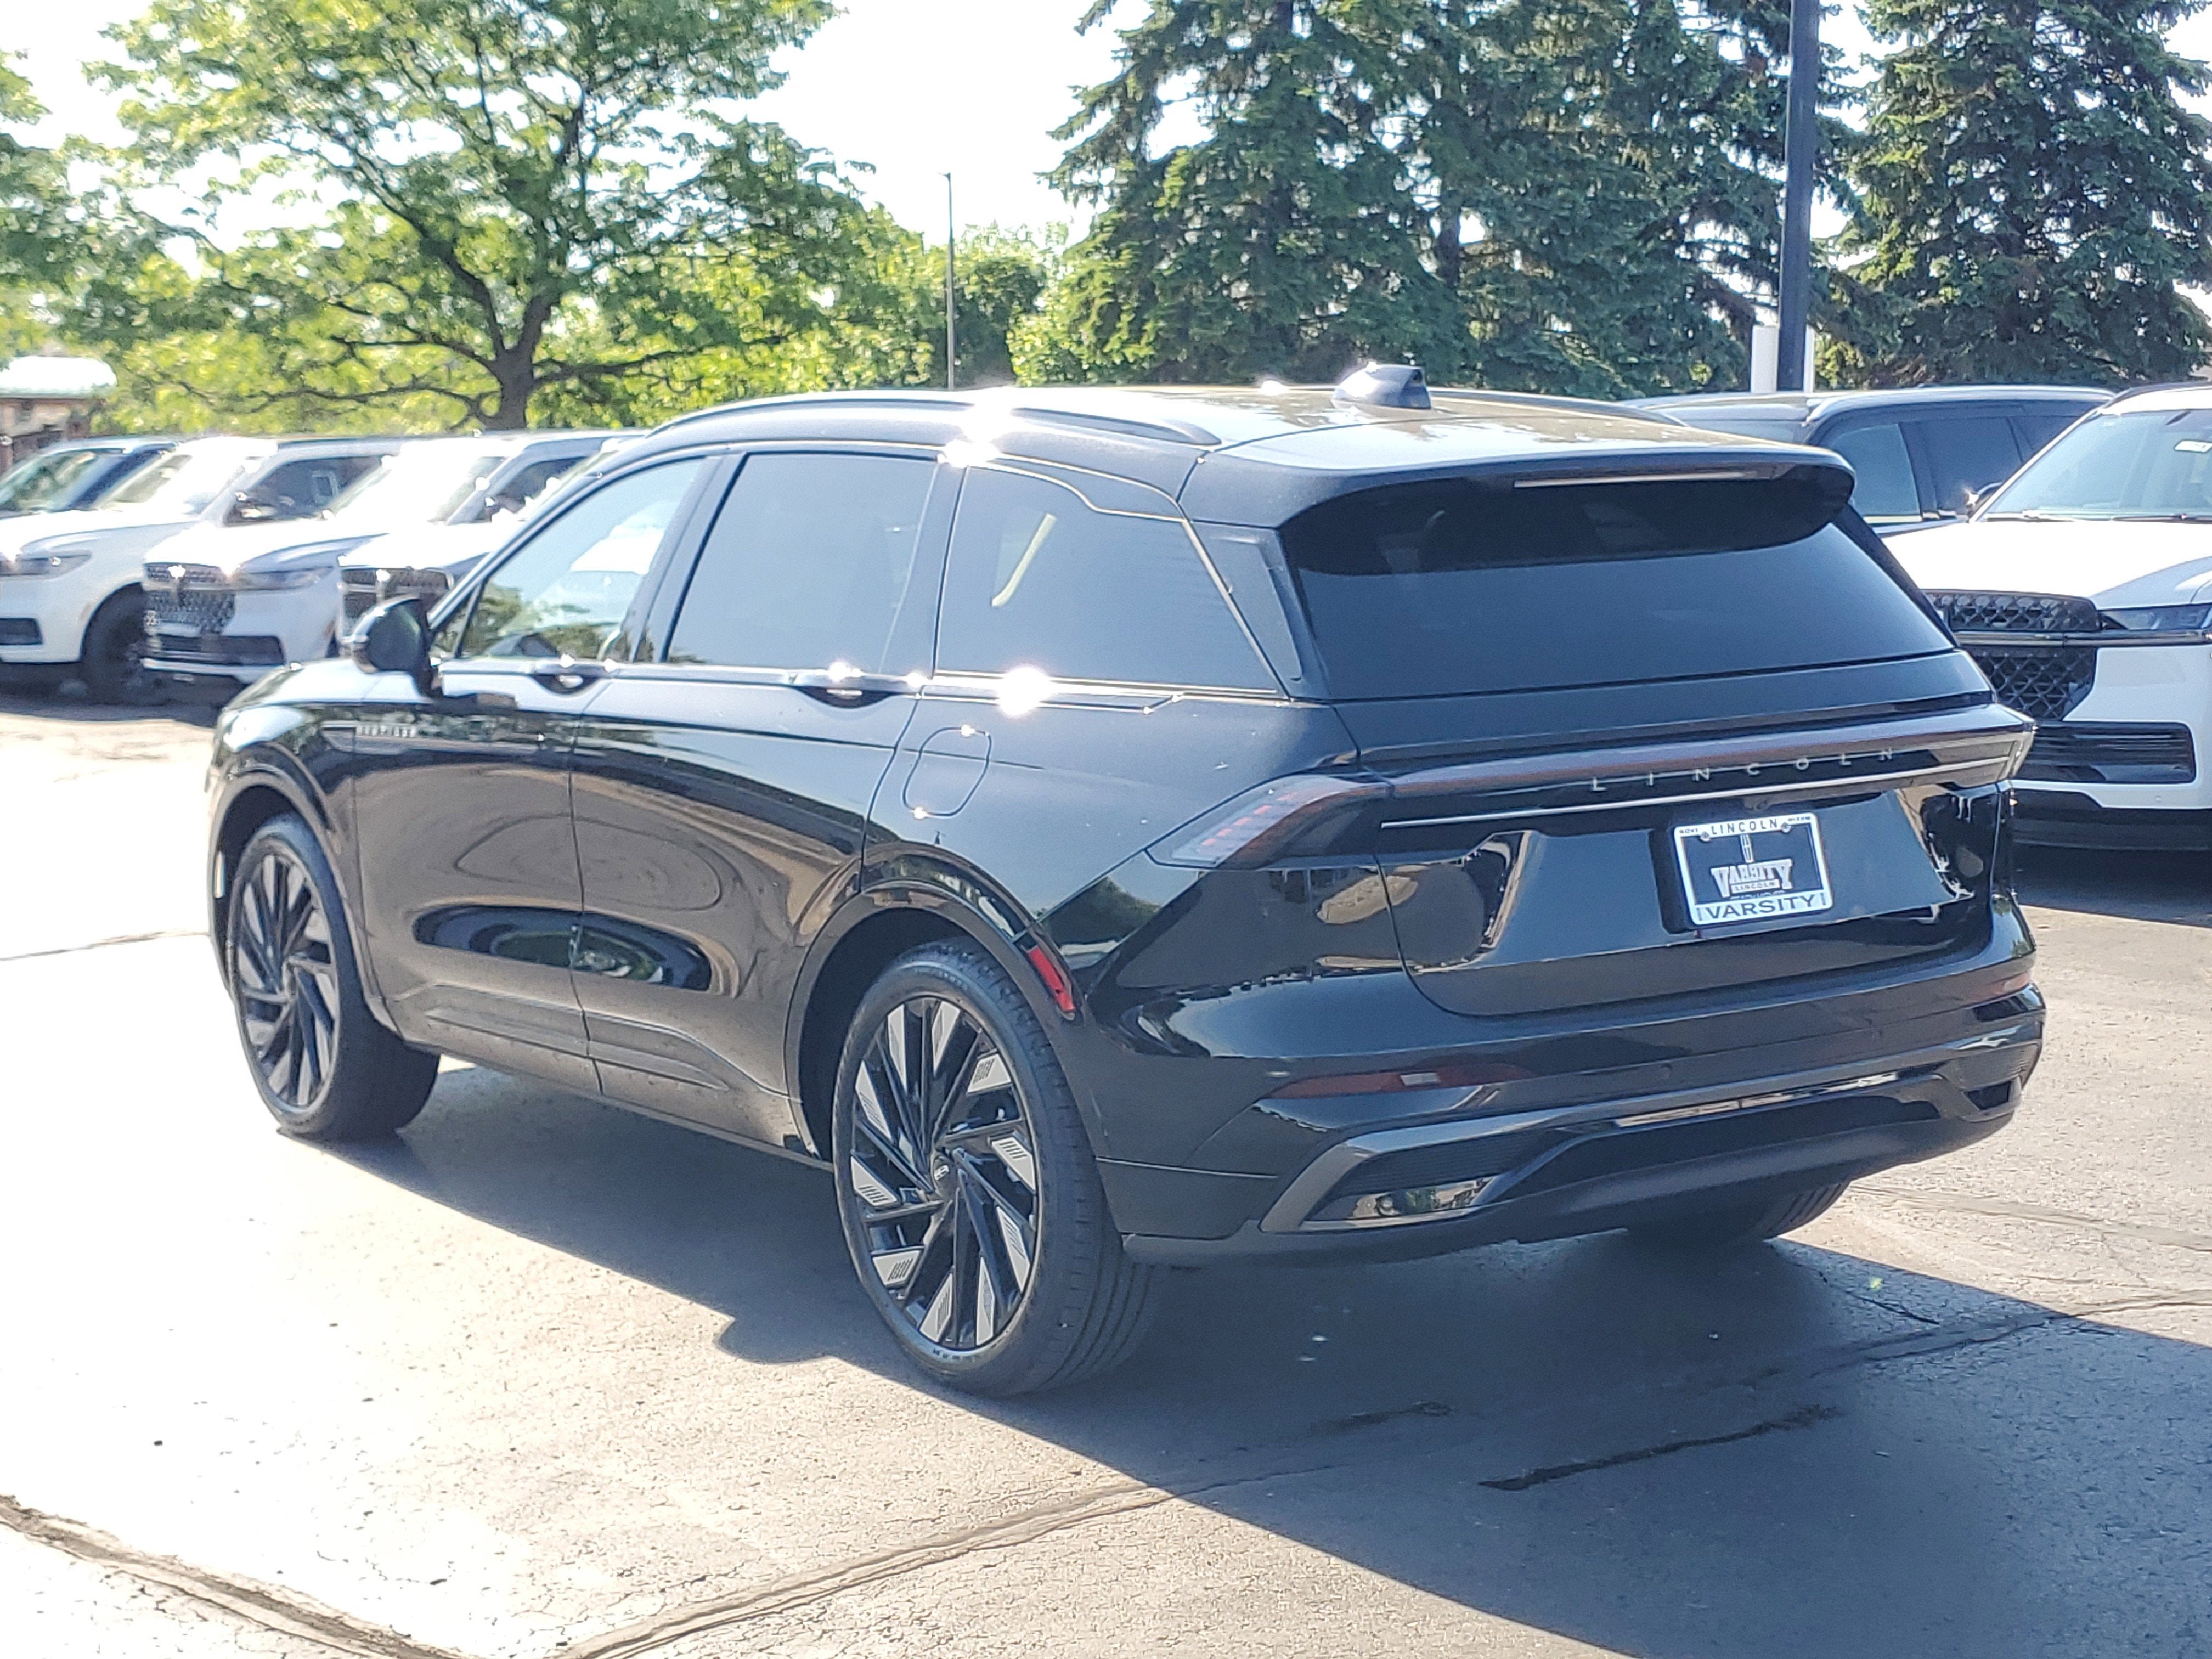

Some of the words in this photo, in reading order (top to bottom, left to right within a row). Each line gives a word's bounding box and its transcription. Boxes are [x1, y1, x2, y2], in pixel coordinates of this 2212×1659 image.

[1591, 747, 1893, 792] LINCOLN
[1711, 819, 1778, 835] LINCOLN
[1710, 858, 1793, 898] VARSITY
[1734, 881, 1775, 892] LINCOLN
[1705, 894, 1816, 919] VARSITY
